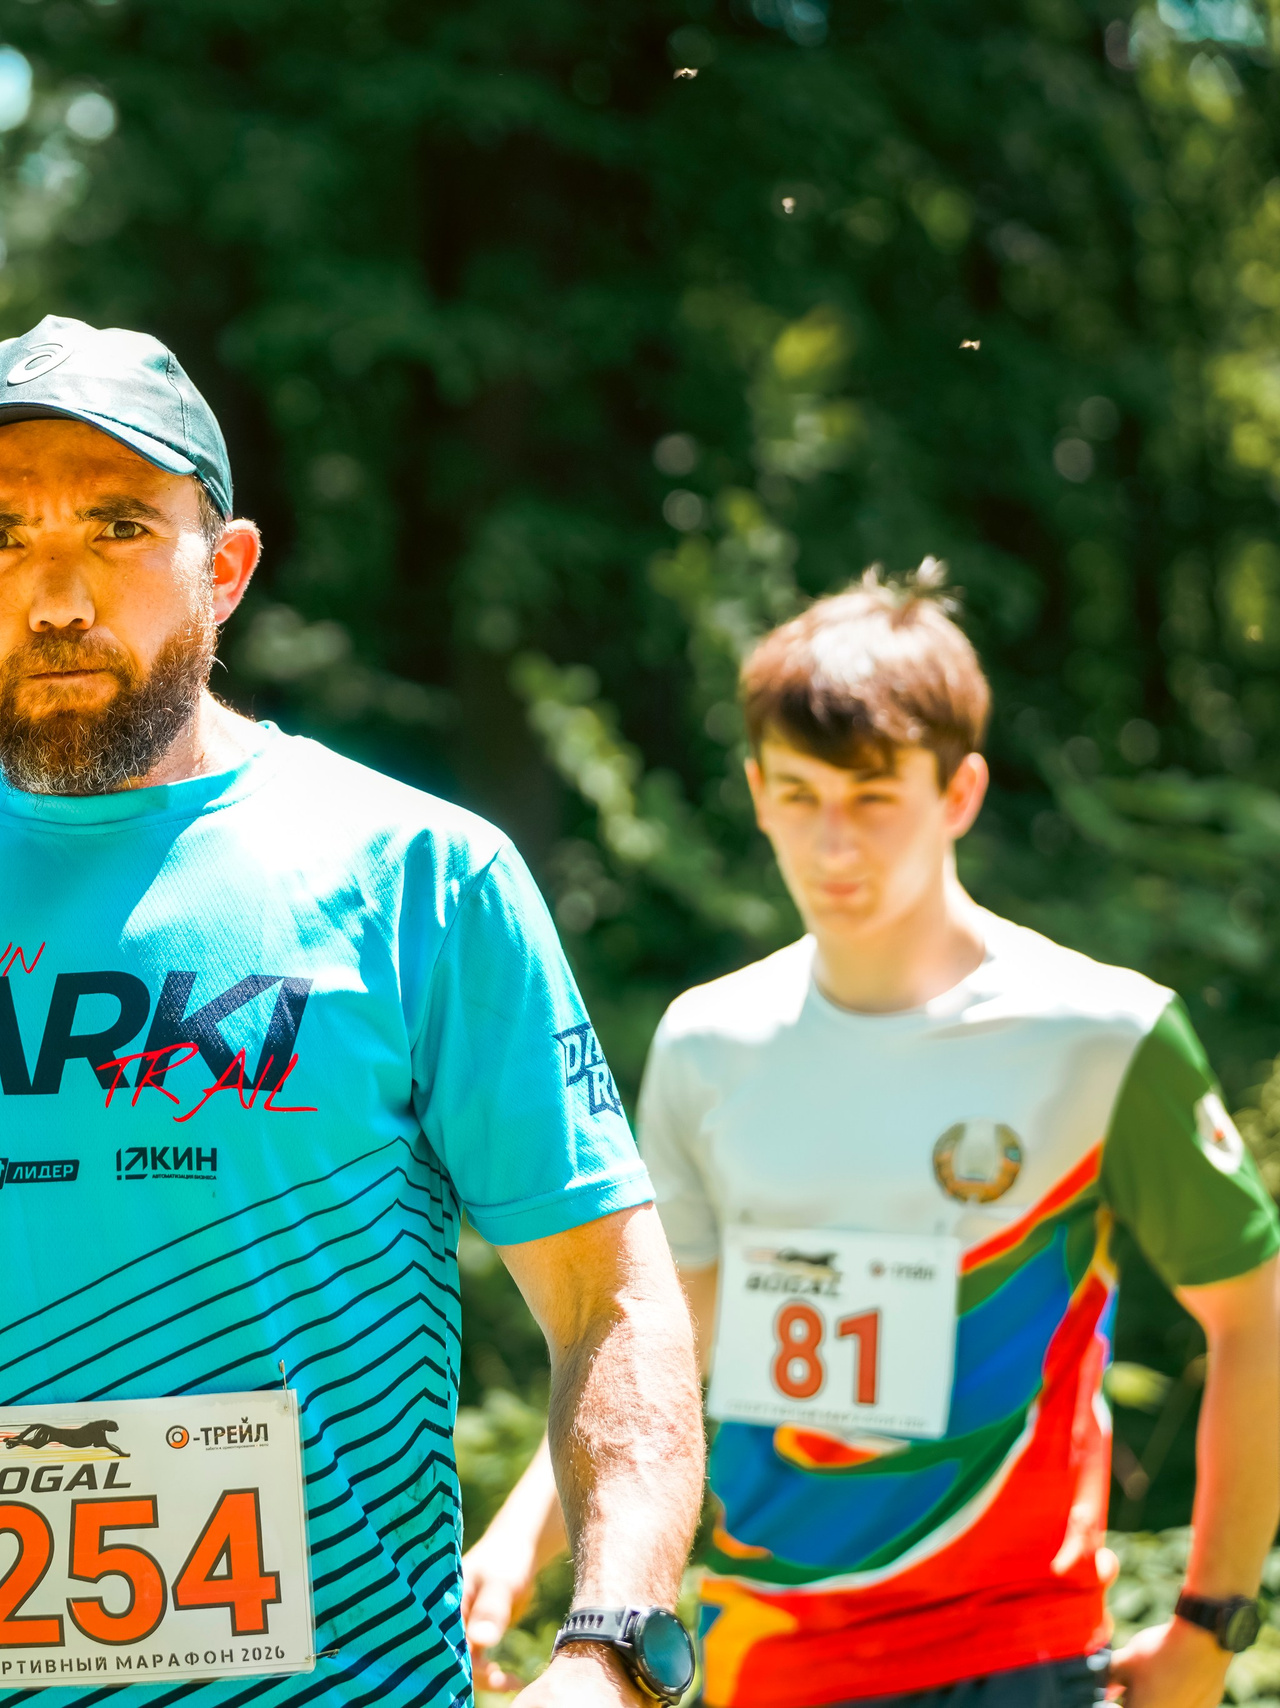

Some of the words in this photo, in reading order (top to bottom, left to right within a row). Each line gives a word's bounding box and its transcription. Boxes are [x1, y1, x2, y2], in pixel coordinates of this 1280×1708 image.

[96, 1043, 319, 1122] TRAIL
[12, 1164, 75, 1180] ЛИДЕР
[772, 1299, 882, 1407] 81
[116, 1648, 234, 1670] МАРАФОН
[241, 1645, 286, 1662] 2026
